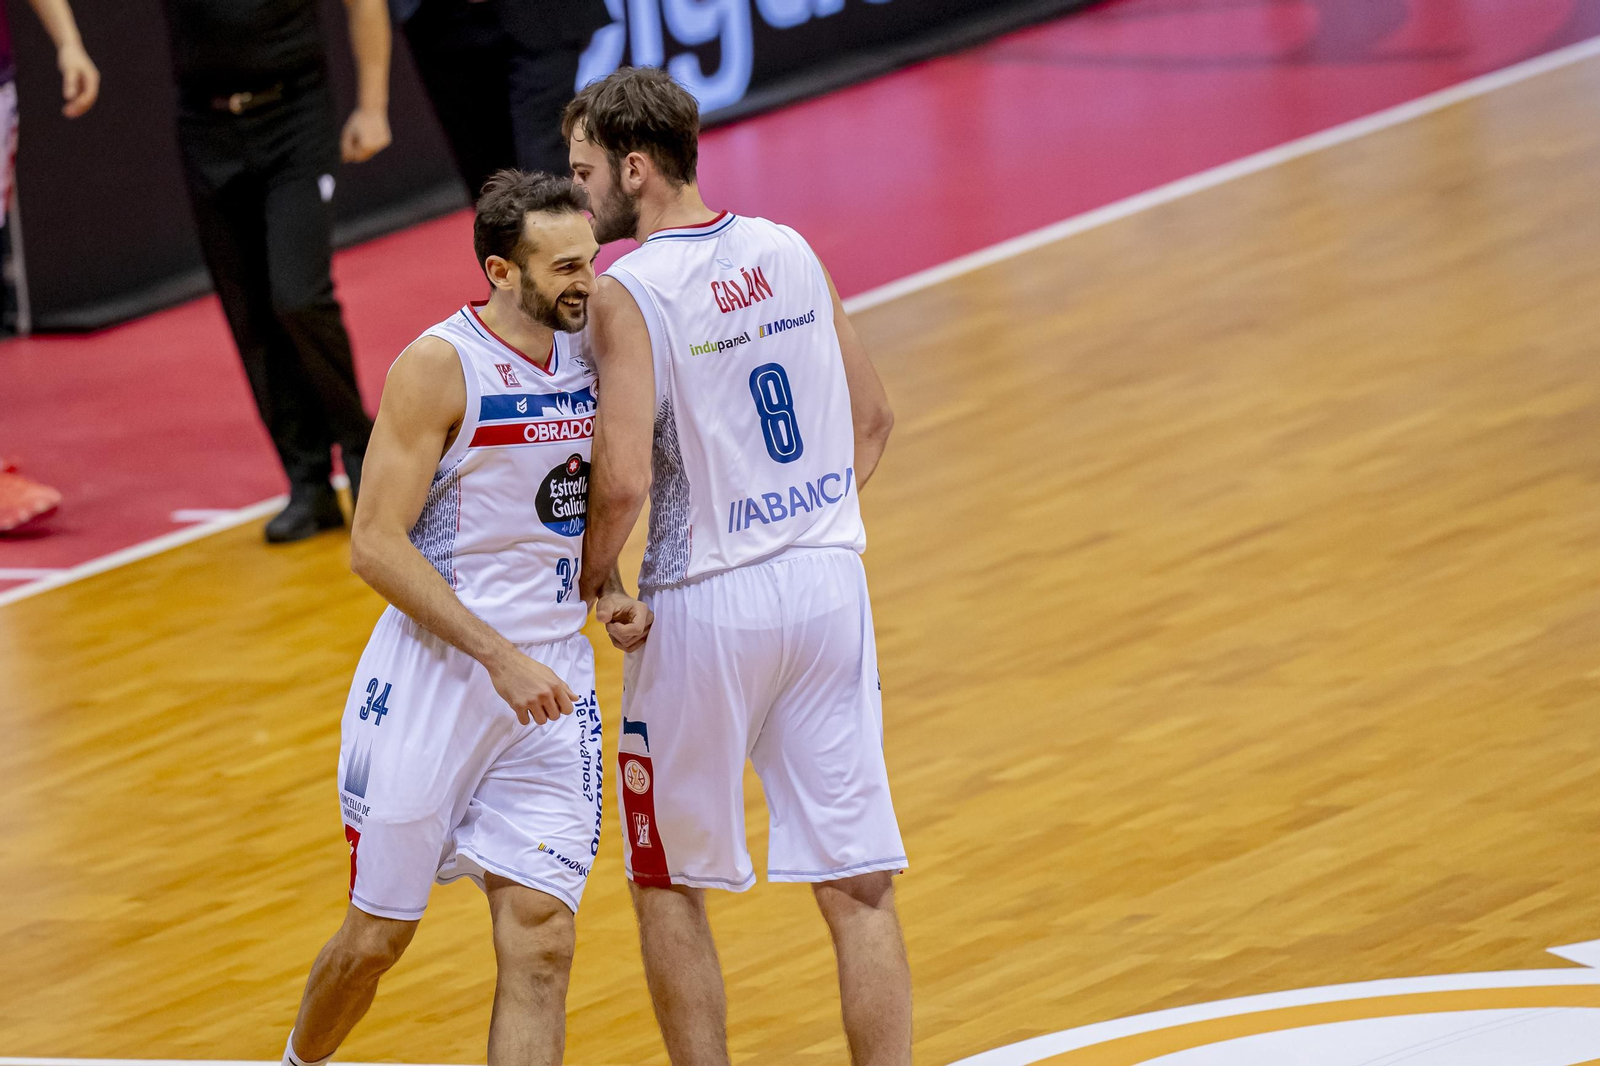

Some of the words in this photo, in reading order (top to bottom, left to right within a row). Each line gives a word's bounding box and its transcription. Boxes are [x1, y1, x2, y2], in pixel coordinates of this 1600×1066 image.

[710, 266, 774, 314] GALÁN
[689, 331, 751, 356] indupanel
[523, 418, 596, 442] OBRADO
[748, 362, 804, 464] 8
[359, 677, 393, 727] 34
[361, 804, 371, 817] DE
